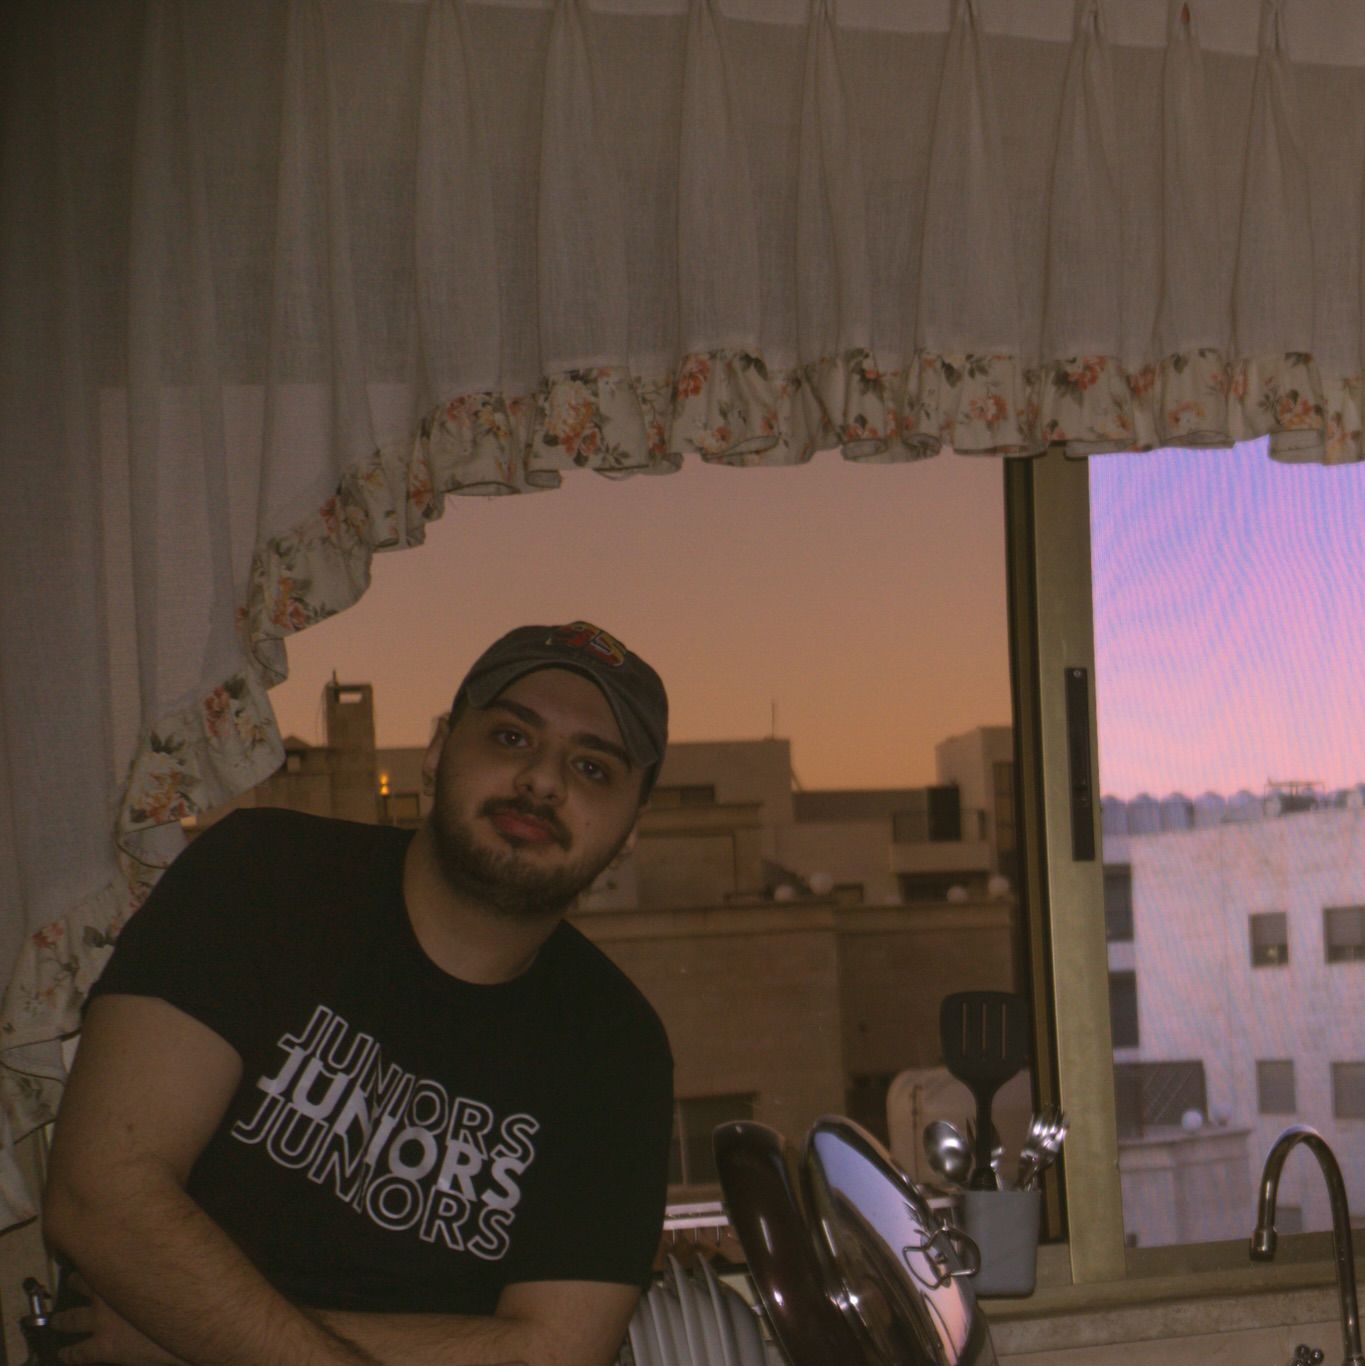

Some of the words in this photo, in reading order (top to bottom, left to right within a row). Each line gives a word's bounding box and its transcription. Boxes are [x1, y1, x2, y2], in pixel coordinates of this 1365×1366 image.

[256, 1044, 526, 1212] JUNIORS
[278, 1004, 540, 1167] JUNIORS
[231, 1092, 516, 1261] JUNIORS
